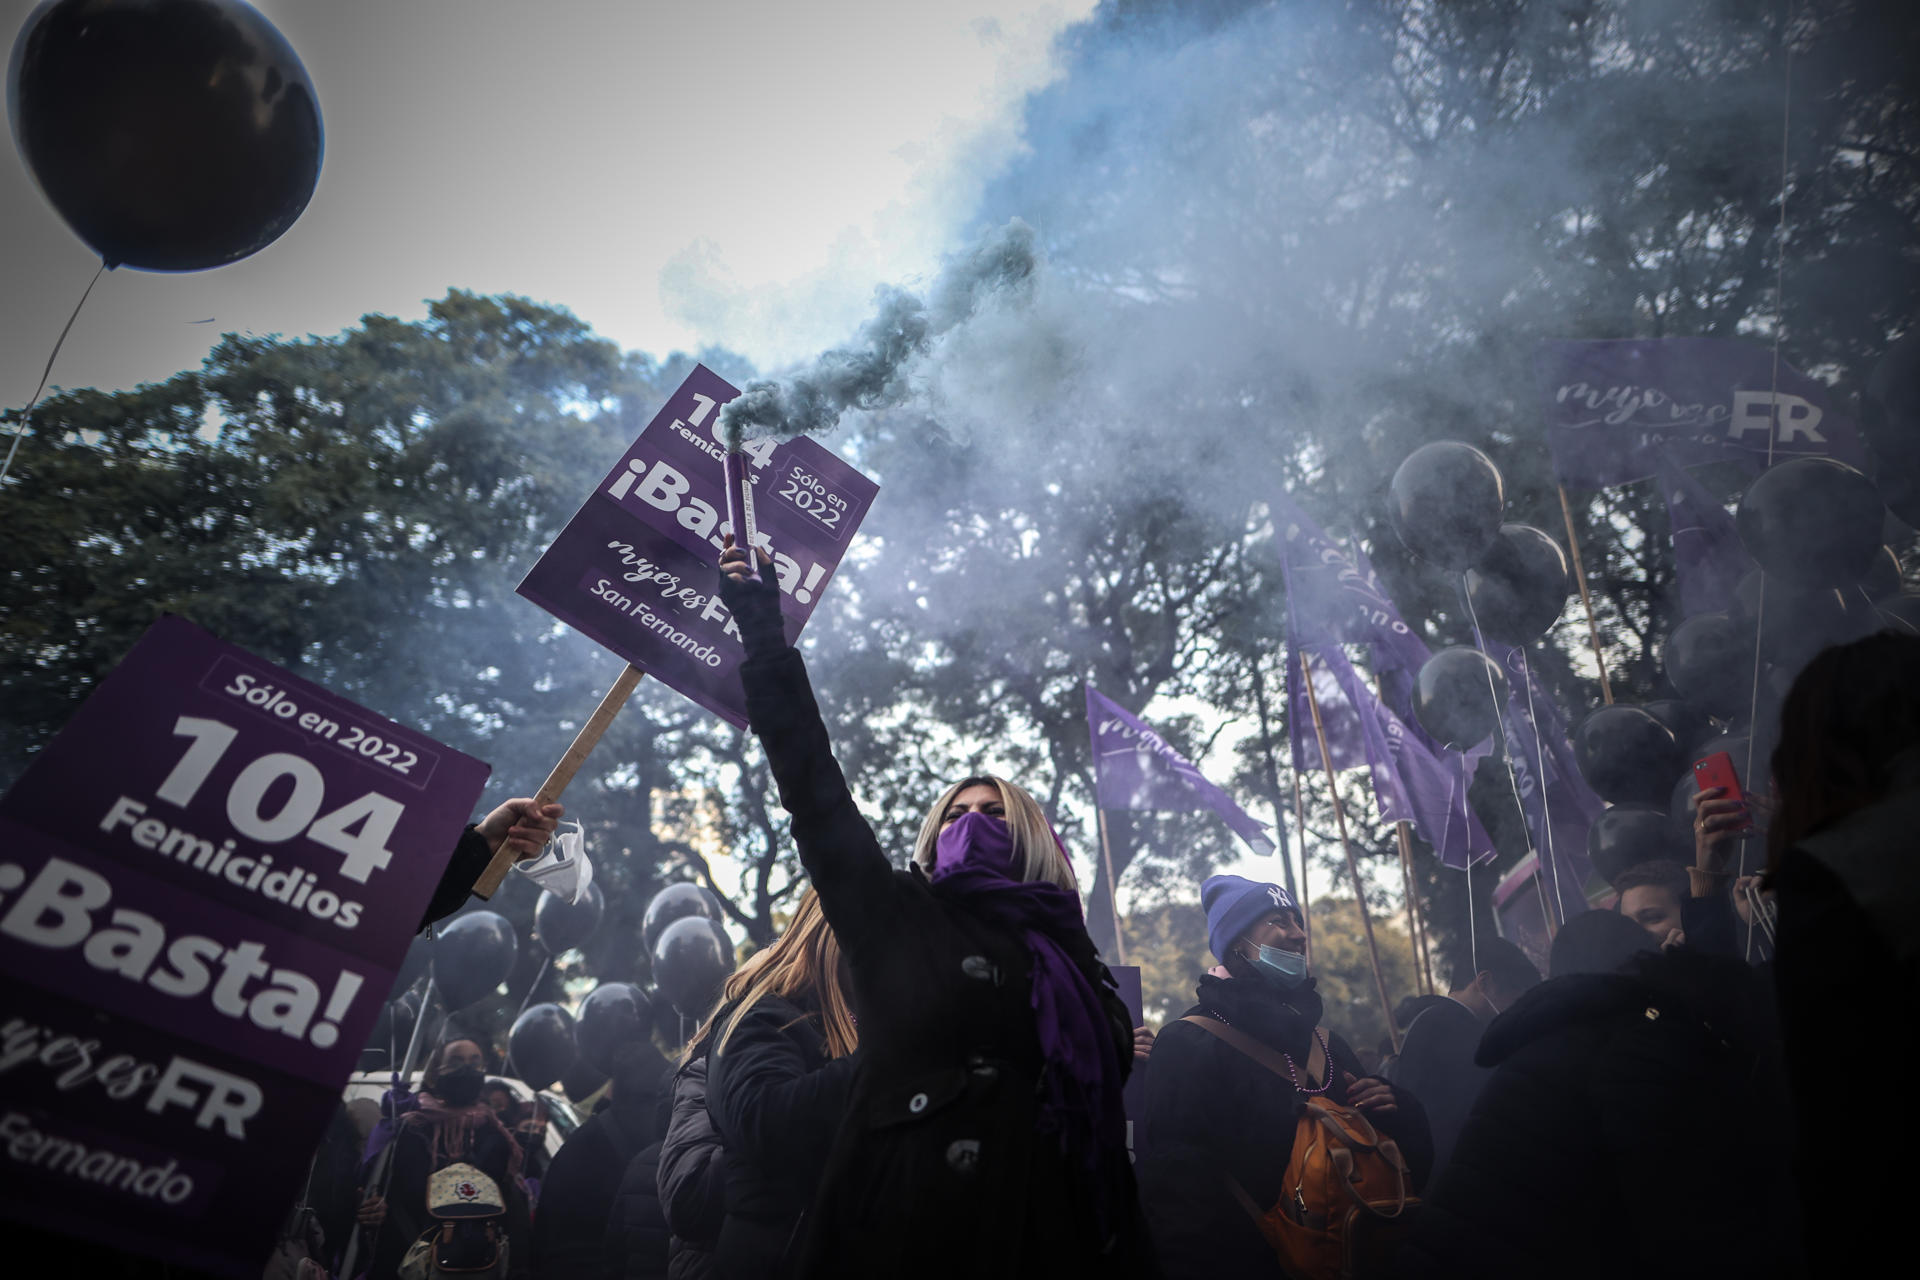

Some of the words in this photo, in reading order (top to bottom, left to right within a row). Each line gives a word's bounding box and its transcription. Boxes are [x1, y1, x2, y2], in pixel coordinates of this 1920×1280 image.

[669, 418, 760, 485] Femicis
[790, 465, 824, 496] Sólo
[825, 488, 848, 512] en
[779, 480, 841, 530] 2022
[590, 579, 632, 612] San
[629, 602, 722, 667] Fernando
[225, 673, 298, 720] Sólo
[298, 708, 340, 743] en
[338, 726, 420, 775] 2022
[155, 716, 406, 886] 104
[100, 796, 364, 930] Femicidios
[1267, 886, 1292, 907] NY
[0, 857, 365, 1050] Basta!
